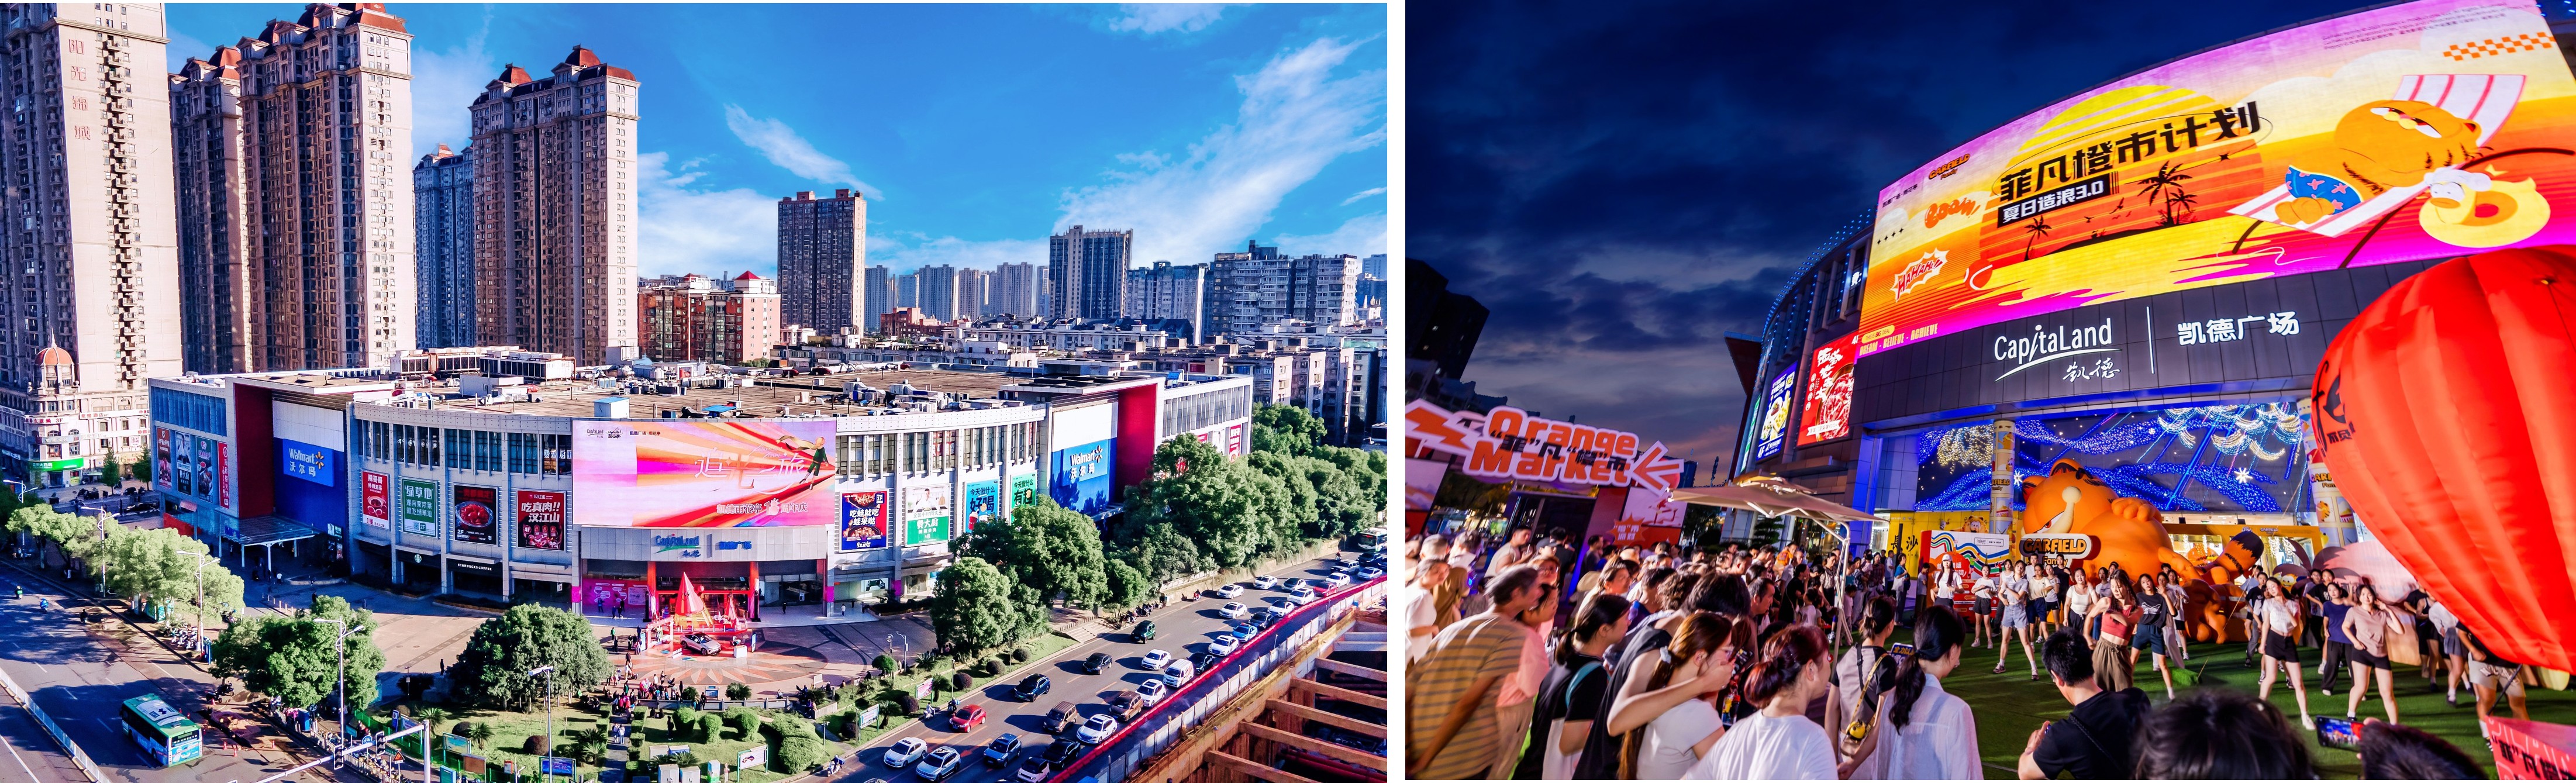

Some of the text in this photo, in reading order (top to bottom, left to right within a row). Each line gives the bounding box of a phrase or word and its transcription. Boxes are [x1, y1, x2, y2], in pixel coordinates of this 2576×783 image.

[69, 38, 91, 140] 阳光锦城
[1999, 101, 2261, 202] 菲凡橙市计划
[1929, 153, 1971, 180] GARFIELD
[2002, 180, 2104, 223] 夏日造浪3.0
[2177, 311, 2301, 346] 凯德广场
[1859, 323, 1939, 356] DREAM BELIEVE ACHIEVE
[1994, 318, 2112, 362] CapitaLand
[1488, 410, 1636, 460] Orange
[289, 448, 315, 464] Walmart
[1070, 449, 1095, 466] Walmart
[1468, 440, 1632, 483] Market
[289, 461, 316, 477] 沃尔玛
[1070, 463, 1095, 480] 沃尔玛
[970, 486, 995, 496] 今天做什么
[1014, 479, 1034, 489] 今天做什么
[406, 499, 432, 509] 湖南家常菜
[406, 507, 433, 518] 就吃绿草地
[527, 512, 560, 523] 汉江山
[849, 508, 880, 518] 吃蛙就吃
[913, 510, 943, 519] 全国小炒肉大王
[917, 518, 939, 529] 费大厨
[656, 533, 700, 548] CapitaLand
[2023, 538, 2087, 554] GARFIELD
[2043, 556, 2068, 566] Famy
[1894, 646, 1915, 656] 全力以
